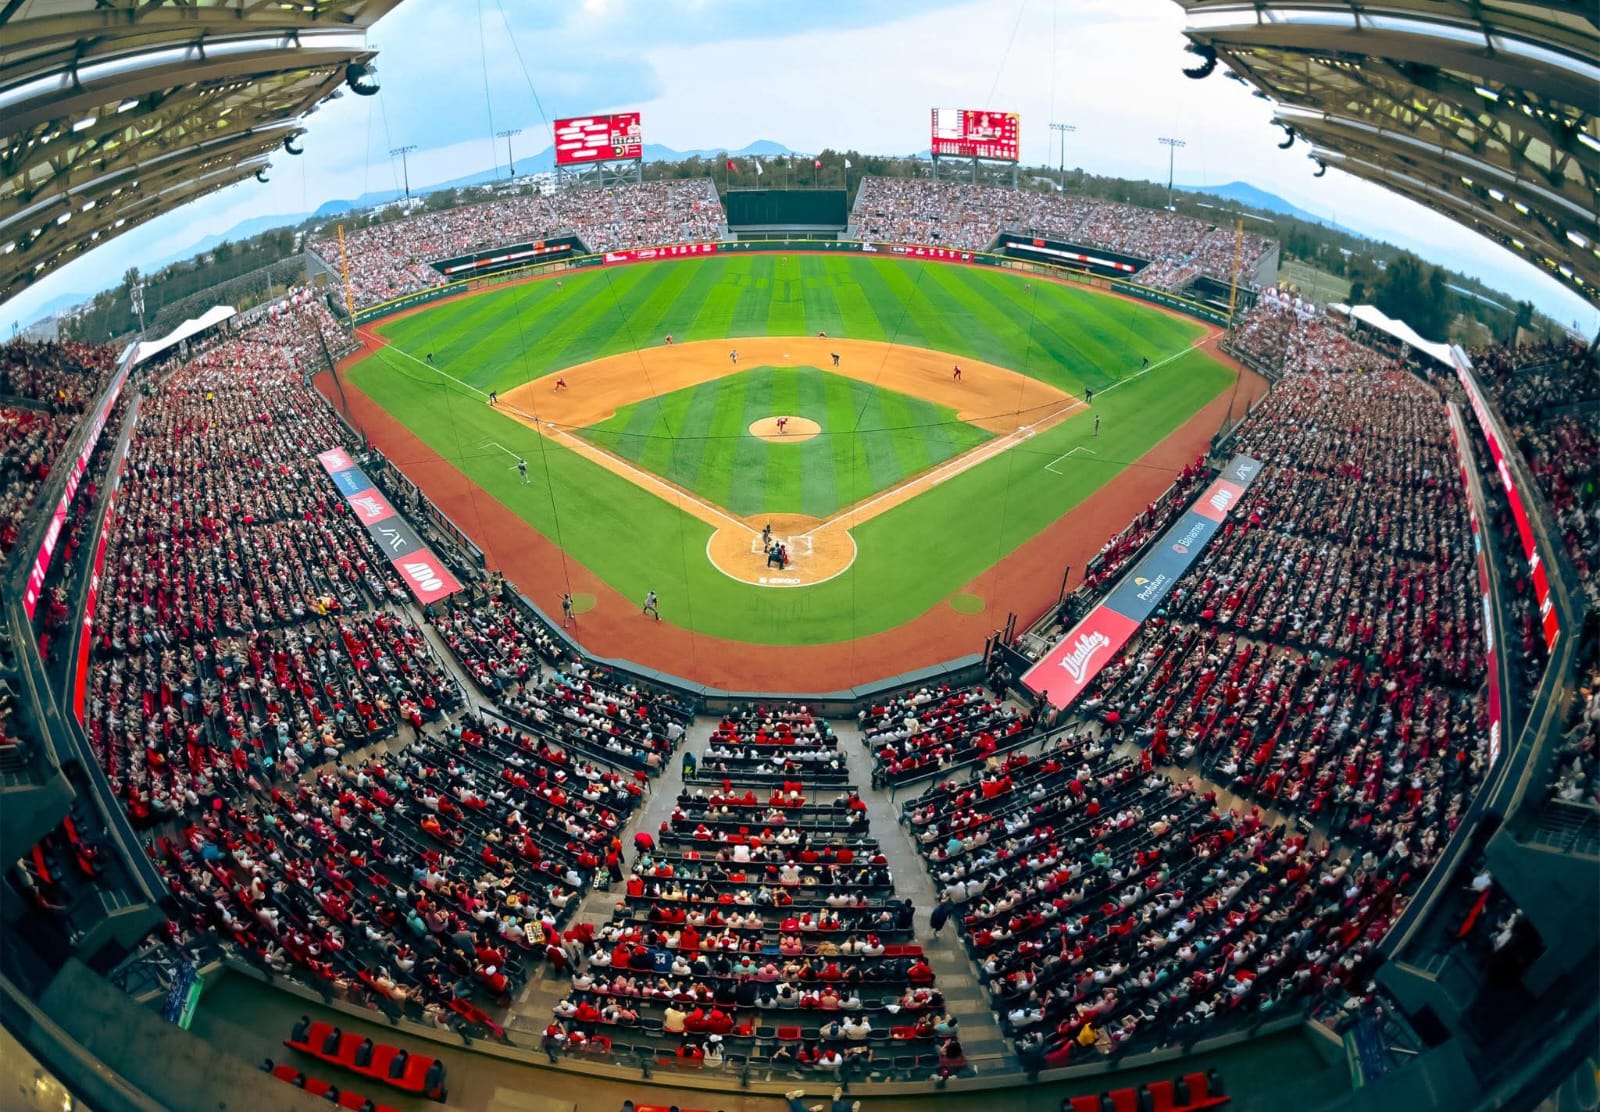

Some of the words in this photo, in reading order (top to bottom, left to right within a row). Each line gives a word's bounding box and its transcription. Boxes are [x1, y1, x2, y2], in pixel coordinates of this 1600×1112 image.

[1180, 522, 1206, 548] Banamex
[402, 562, 443, 592] ADO
[1138, 573, 1166, 601] Profuturo
[1058, 630, 1109, 684] Diablos
